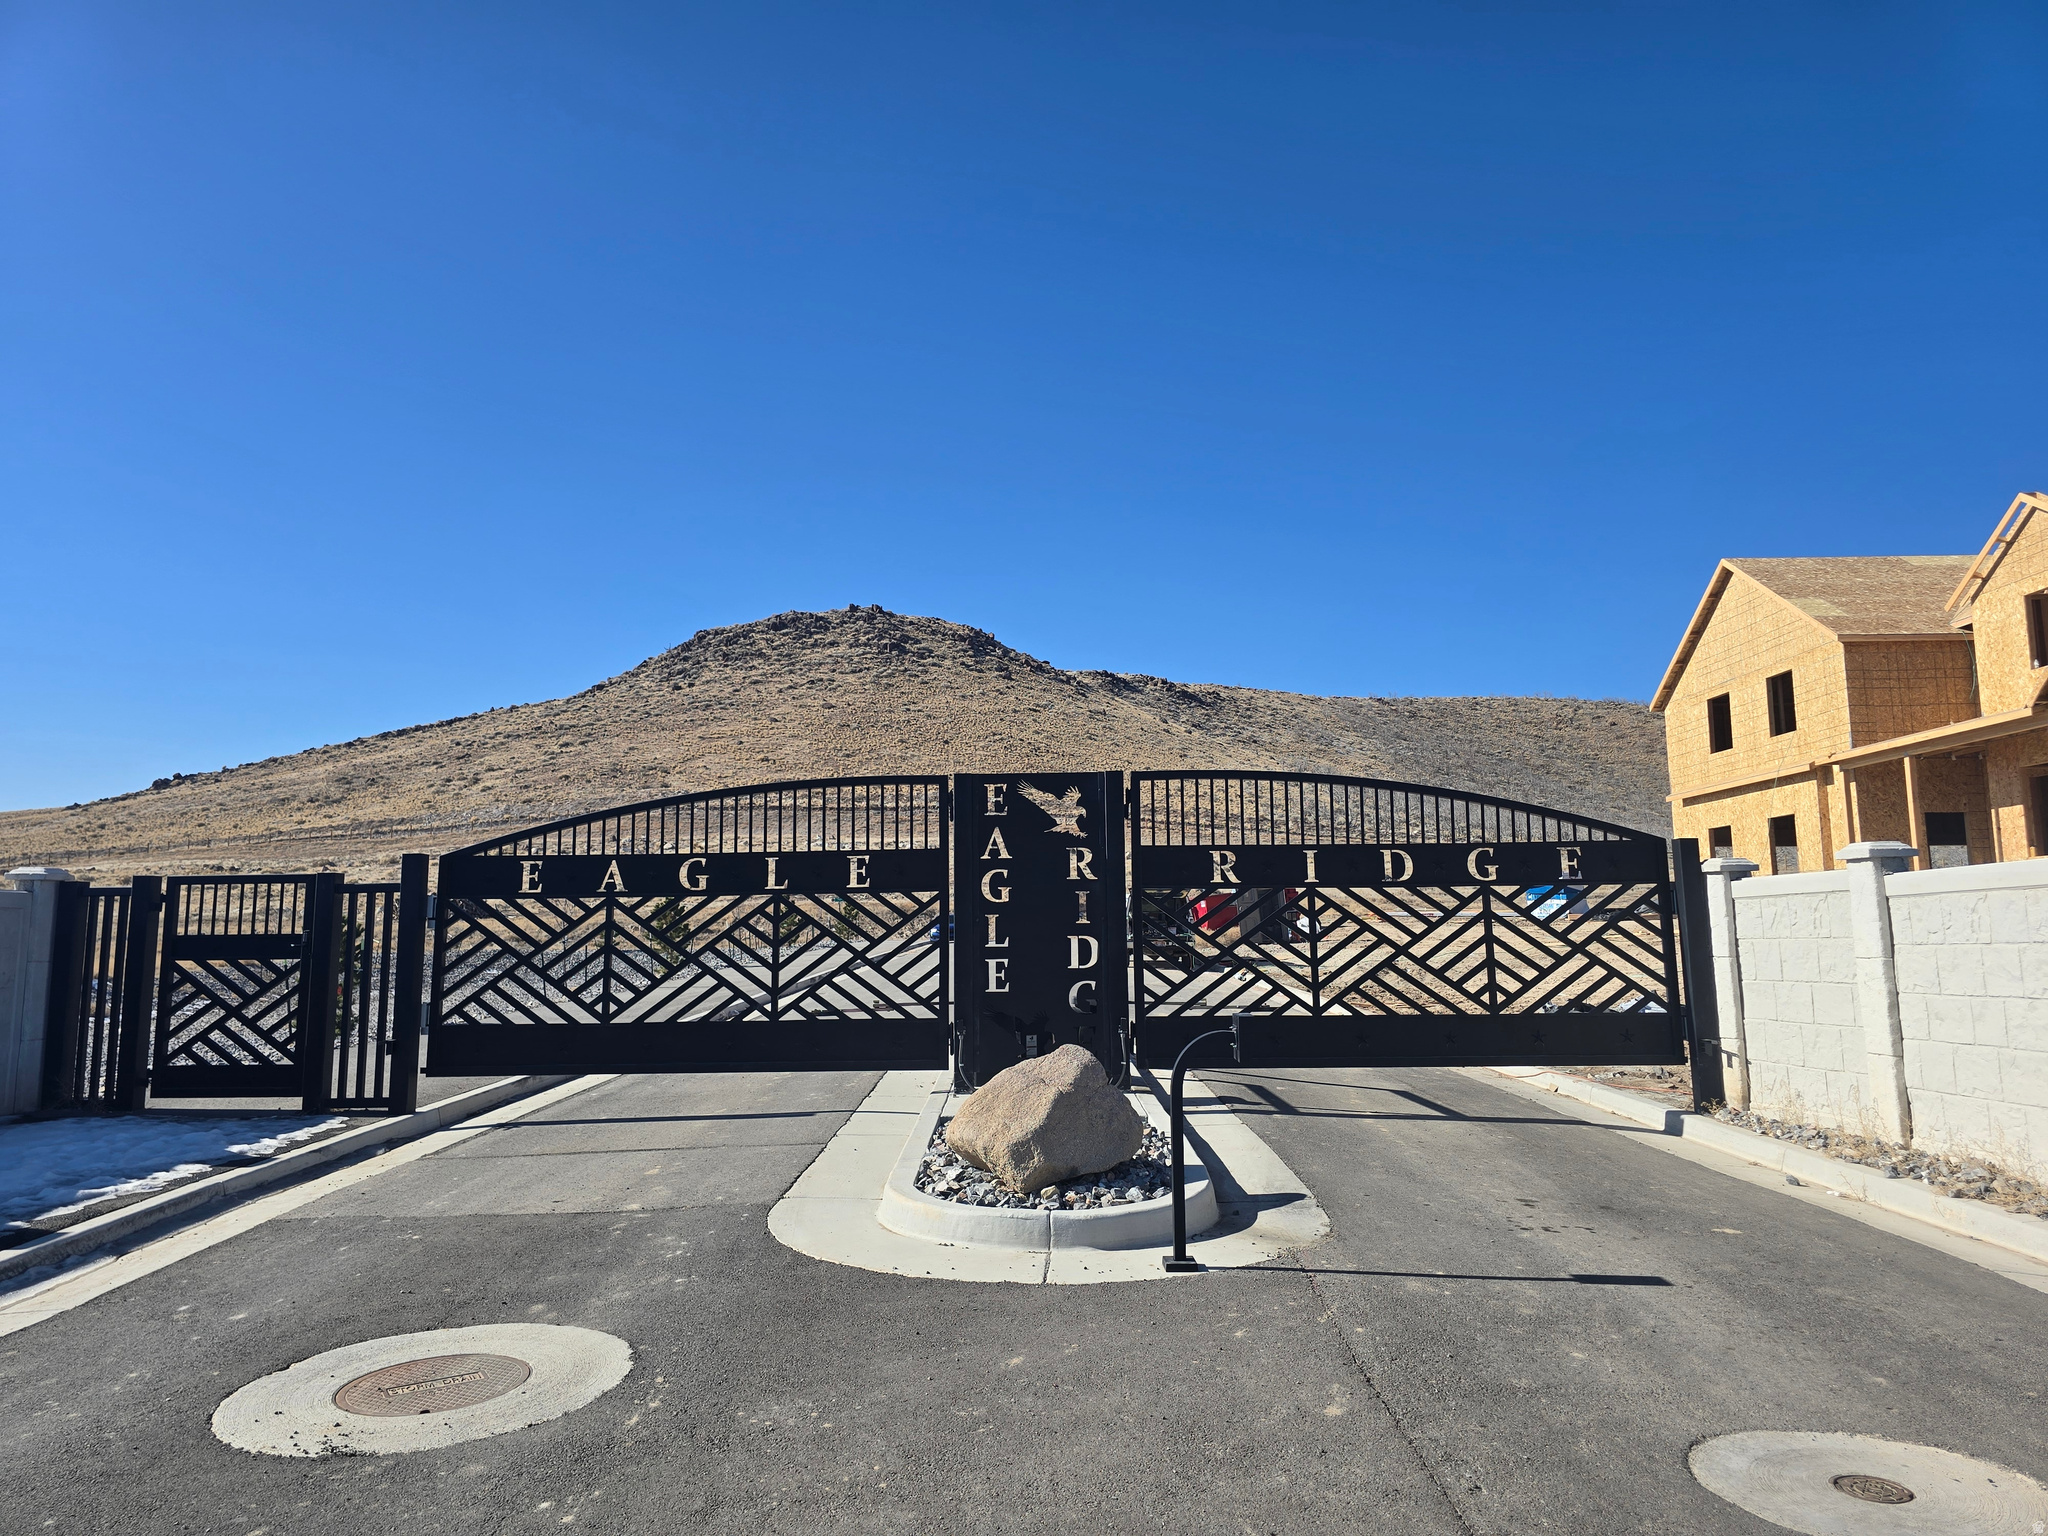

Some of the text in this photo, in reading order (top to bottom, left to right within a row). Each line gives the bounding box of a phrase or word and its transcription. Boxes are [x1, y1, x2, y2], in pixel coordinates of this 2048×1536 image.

[518, 855, 871, 894] EAGLE
[1208, 846, 1583, 884] RIDGE
[980, 783, 1012, 993] EAGLE
[388, 1382, 436, 1395] STORM
[441, 1373, 483, 1386] DRAIN
